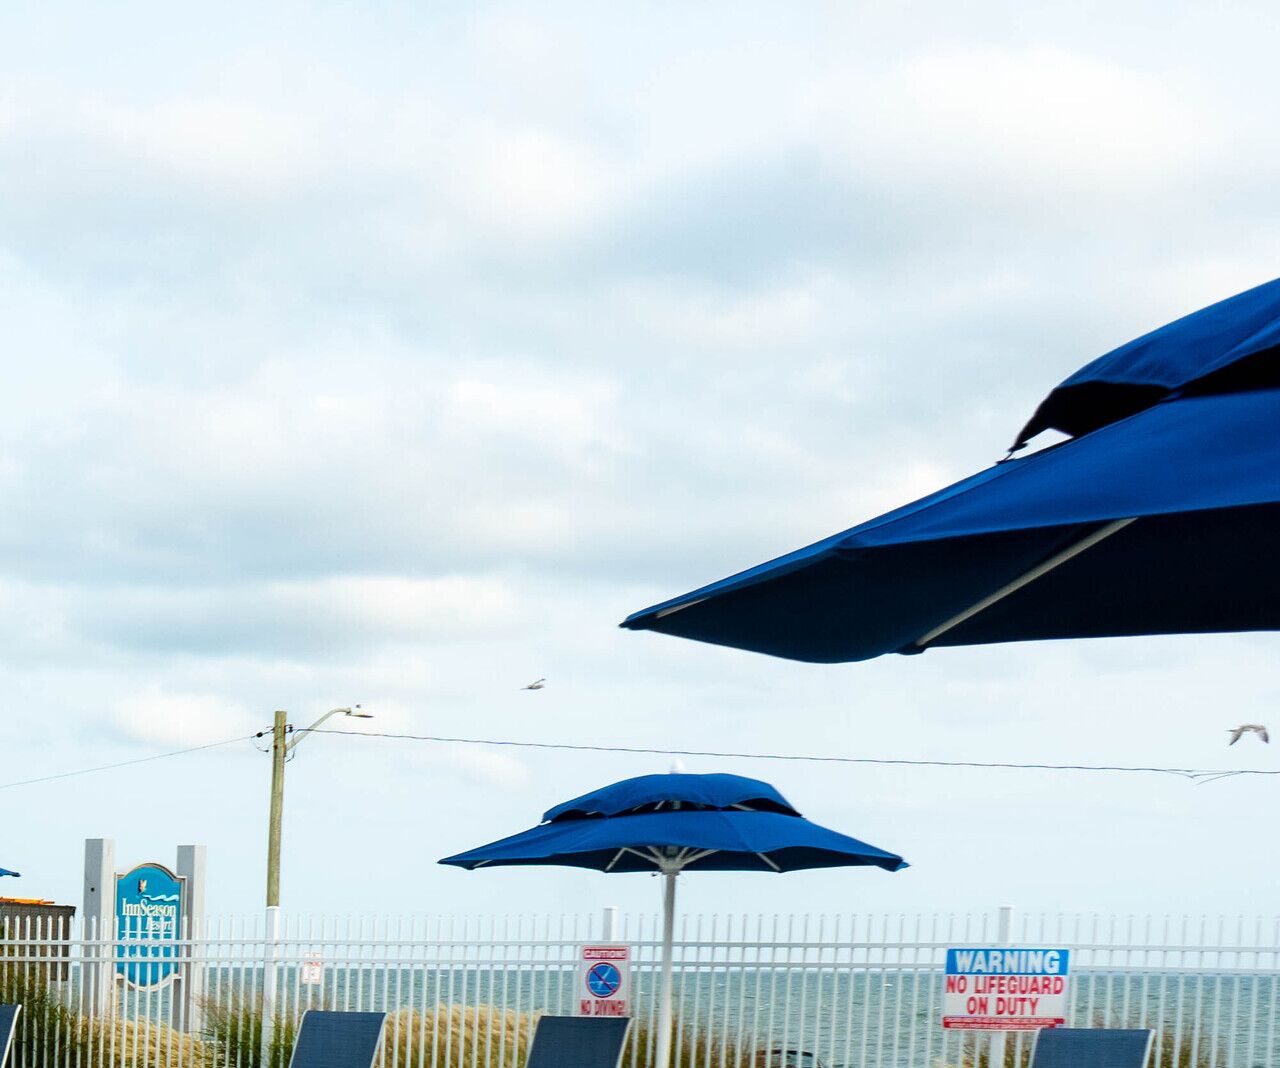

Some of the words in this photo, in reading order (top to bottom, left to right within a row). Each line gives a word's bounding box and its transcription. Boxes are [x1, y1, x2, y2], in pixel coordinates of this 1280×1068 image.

[122, 898, 176, 916] InnSeason
[956, 951, 1060, 974] WARNING
[946, 976, 968, 994] NO
[974, 976, 1064, 995] LIFEGUARD
[581, 1000, 591, 1015] NO
[967, 997, 989, 1014] ON
[996, 997, 1039, 1015] DUTY
